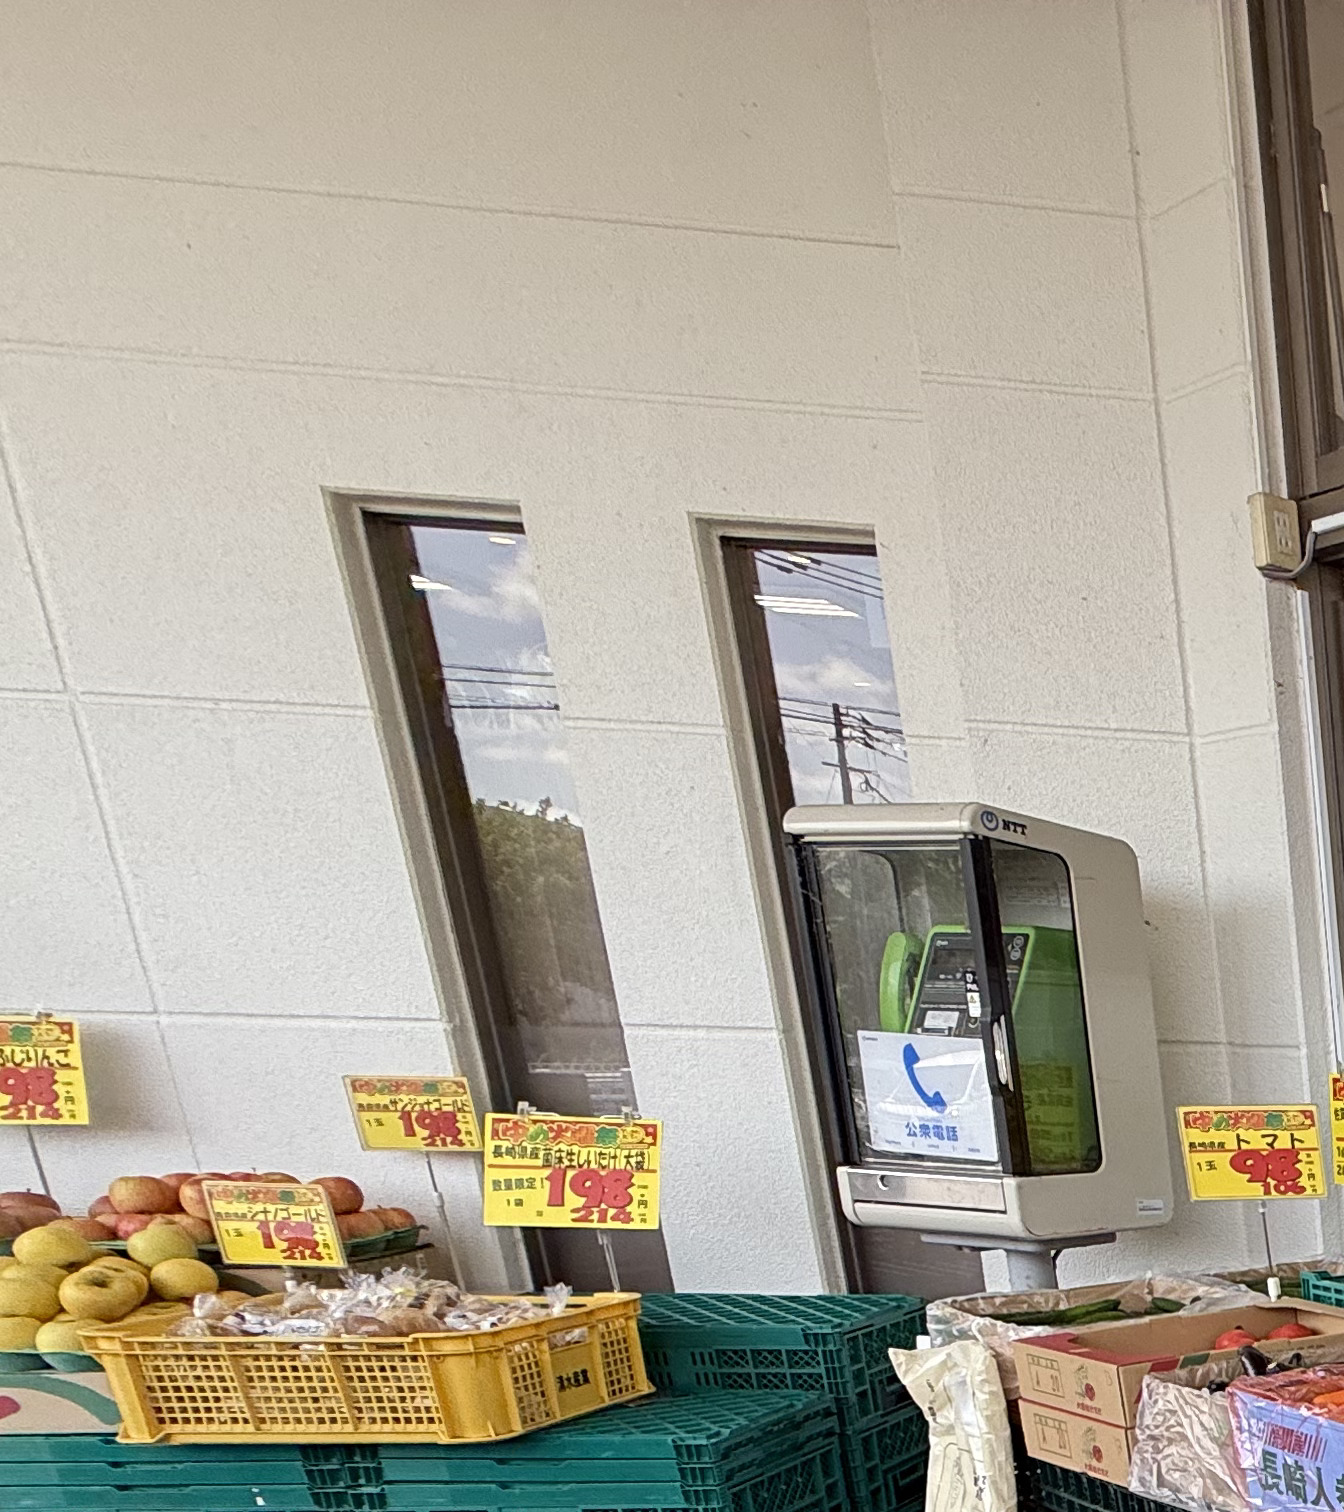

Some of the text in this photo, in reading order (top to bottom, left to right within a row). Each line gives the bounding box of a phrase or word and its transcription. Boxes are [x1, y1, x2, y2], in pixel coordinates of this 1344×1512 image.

[1002, 819, 1028, 836] NTT
[397, 1110, 462, 1138] 198
[904, 1121, 959, 1142] 公衆電話
[1235, 1132, 1305, 1150] トマト
[492, 1145, 541, 1160] 長崎県産
[1196, 1159, 1218, 1172] 1玉
[1229, 1148, 1304, 1184] 98
[545, 1167, 637, 1209] 198
[1260, 1180, 1307, 1196] 106
[246, 1205, 326, 1221] シナノゴールド
[570, 1206, 635, 1225] 214
[256, 1219, 320, 1250] 198
